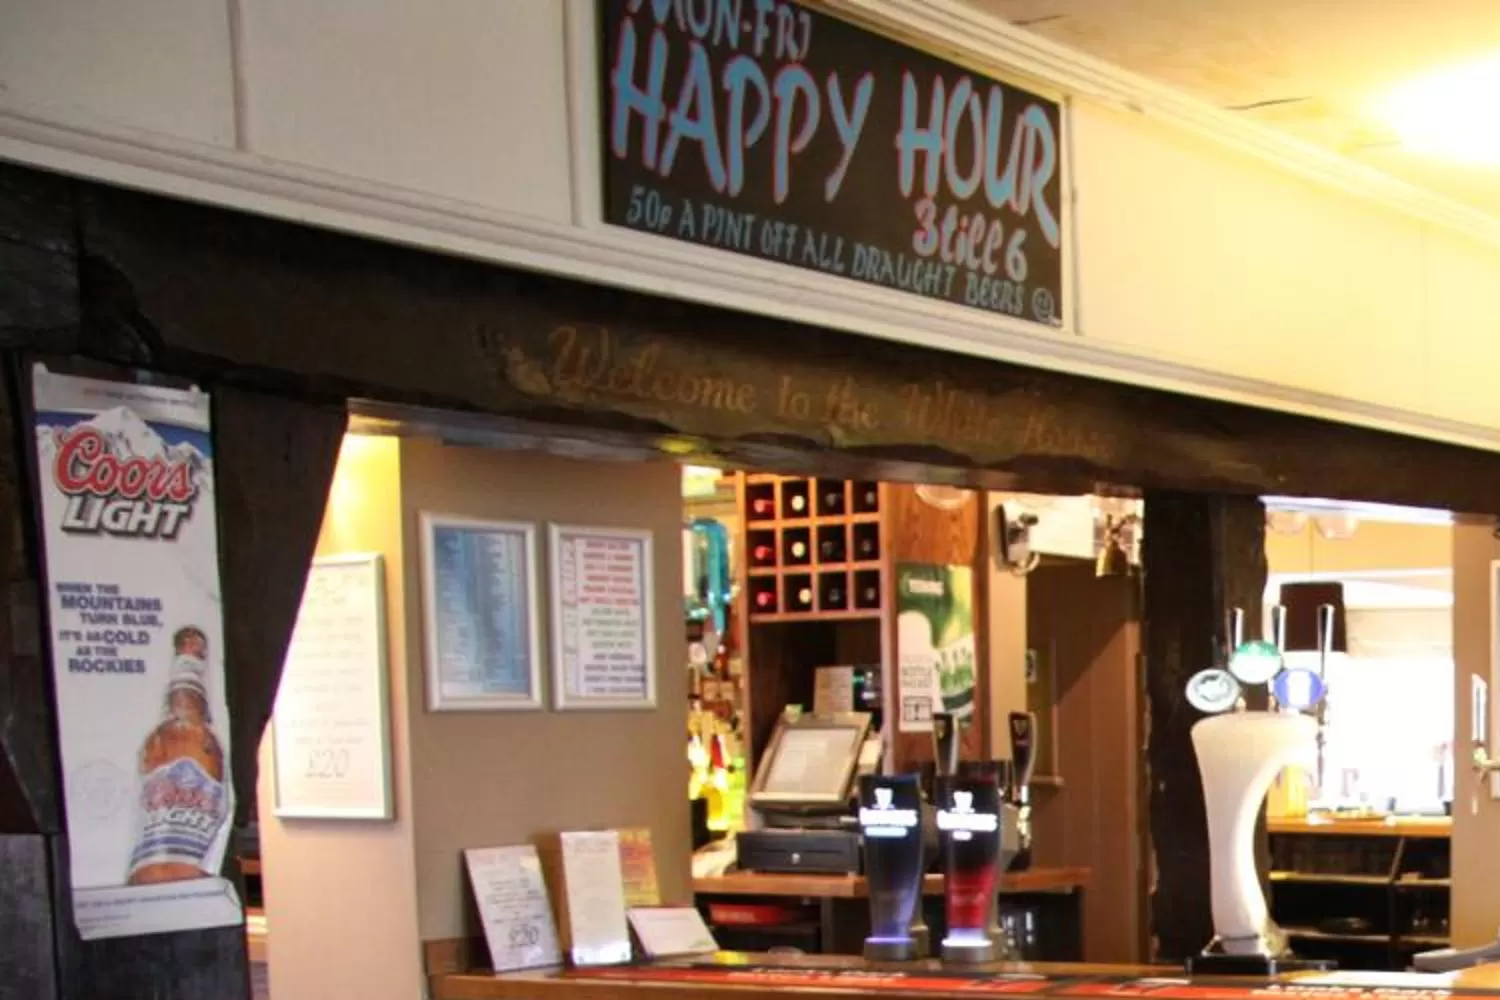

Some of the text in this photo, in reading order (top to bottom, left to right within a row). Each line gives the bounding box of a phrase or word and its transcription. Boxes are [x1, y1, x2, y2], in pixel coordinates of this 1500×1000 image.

[611, 16, 1060, 249] HAPPY HOUR
[626, 184, 673, 232] 50p
[678, 199, 696, 239] A
[702, 203, 756, 250] PINT
[760, 219, 799, 261] OFF
[800, 228, 845, 273] ALL
[851, 243, 957, 298] DRAUGHT
[912, 199, 939, 257] 3
[1005, 229, 1029, 282] 6
[547, 324, 756, 414] Welcome
[778, 373, 810, 420] to
[826, 375, 880, 432] the
[52, 426, 194, 503] Coors
[61, 495, 192, 541] LIGHT
[61, 595, 162, 612] MOUNTAINS
[103, 629, 150, 646] COLD
[68, 658, 146, 674] ROCKIES
